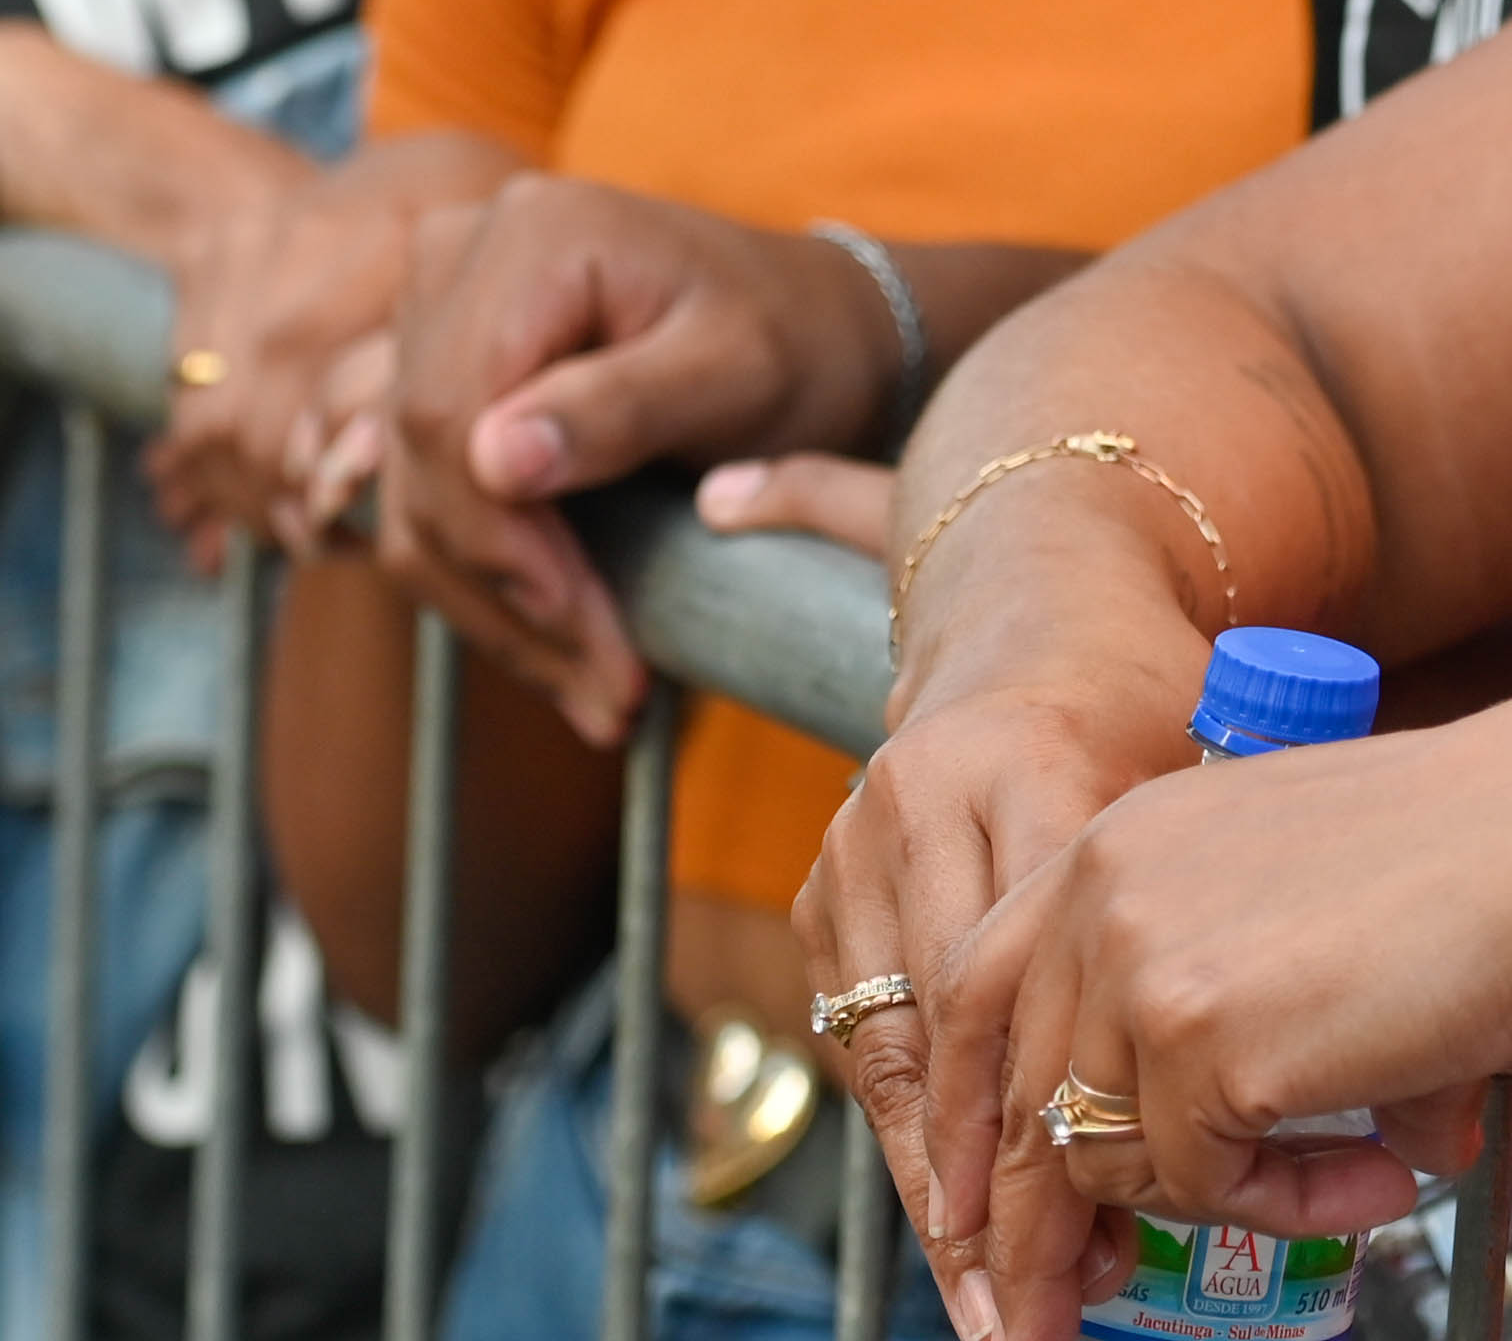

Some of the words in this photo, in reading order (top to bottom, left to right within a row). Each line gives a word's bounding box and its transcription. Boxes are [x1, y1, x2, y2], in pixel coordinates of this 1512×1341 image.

[1204, 1271, 1261, 1297] ÁGUA
[1193, 1298, 1242, 1315] DESDE
[1242, 1302, 1268, 1316] 1997
[1295, 1288, 1331, 1315] 510
[1132, 1312, 1215, 1339] Jacutinga
[1227, 1324, 1252, 1340] Sul
[1266, 1324, 1306, 1339] Minas
